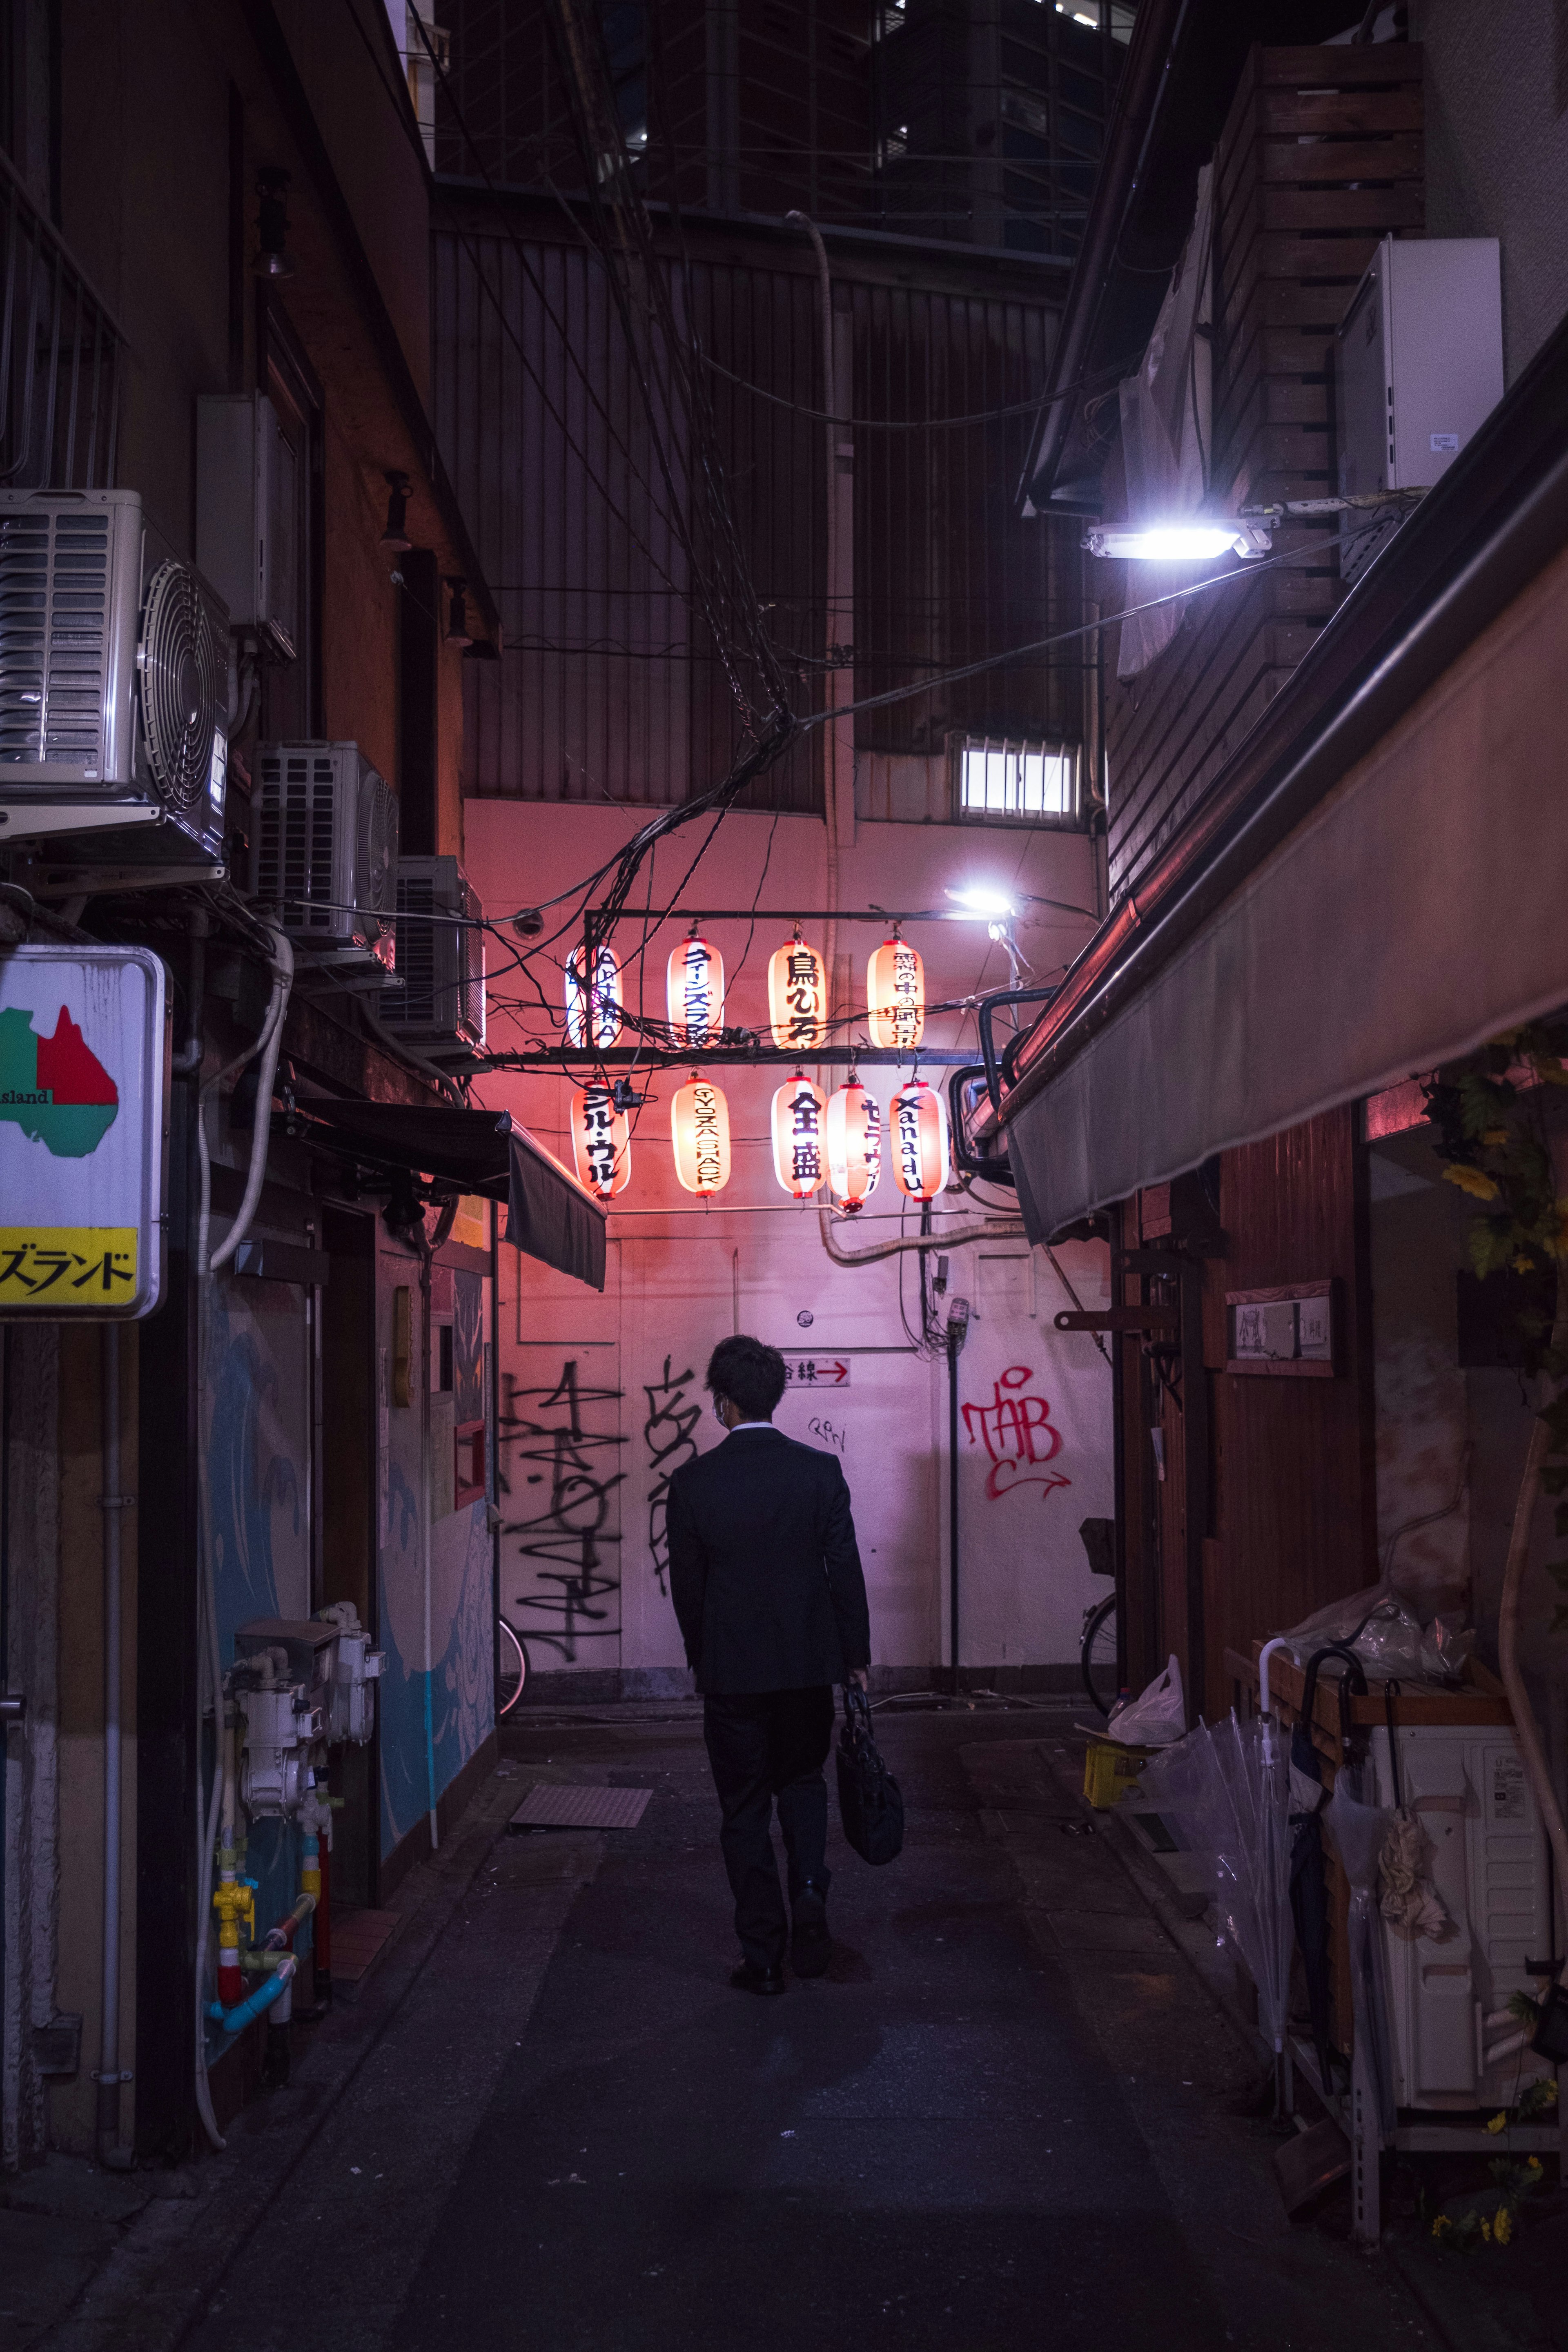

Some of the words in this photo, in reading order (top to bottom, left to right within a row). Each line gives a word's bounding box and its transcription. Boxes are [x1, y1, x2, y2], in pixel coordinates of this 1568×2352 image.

[0, 1090, 49, 1104] sland
[788, 1092, 822, 1180] 全盛
[0, 1243, 134, 1296] ズランド
